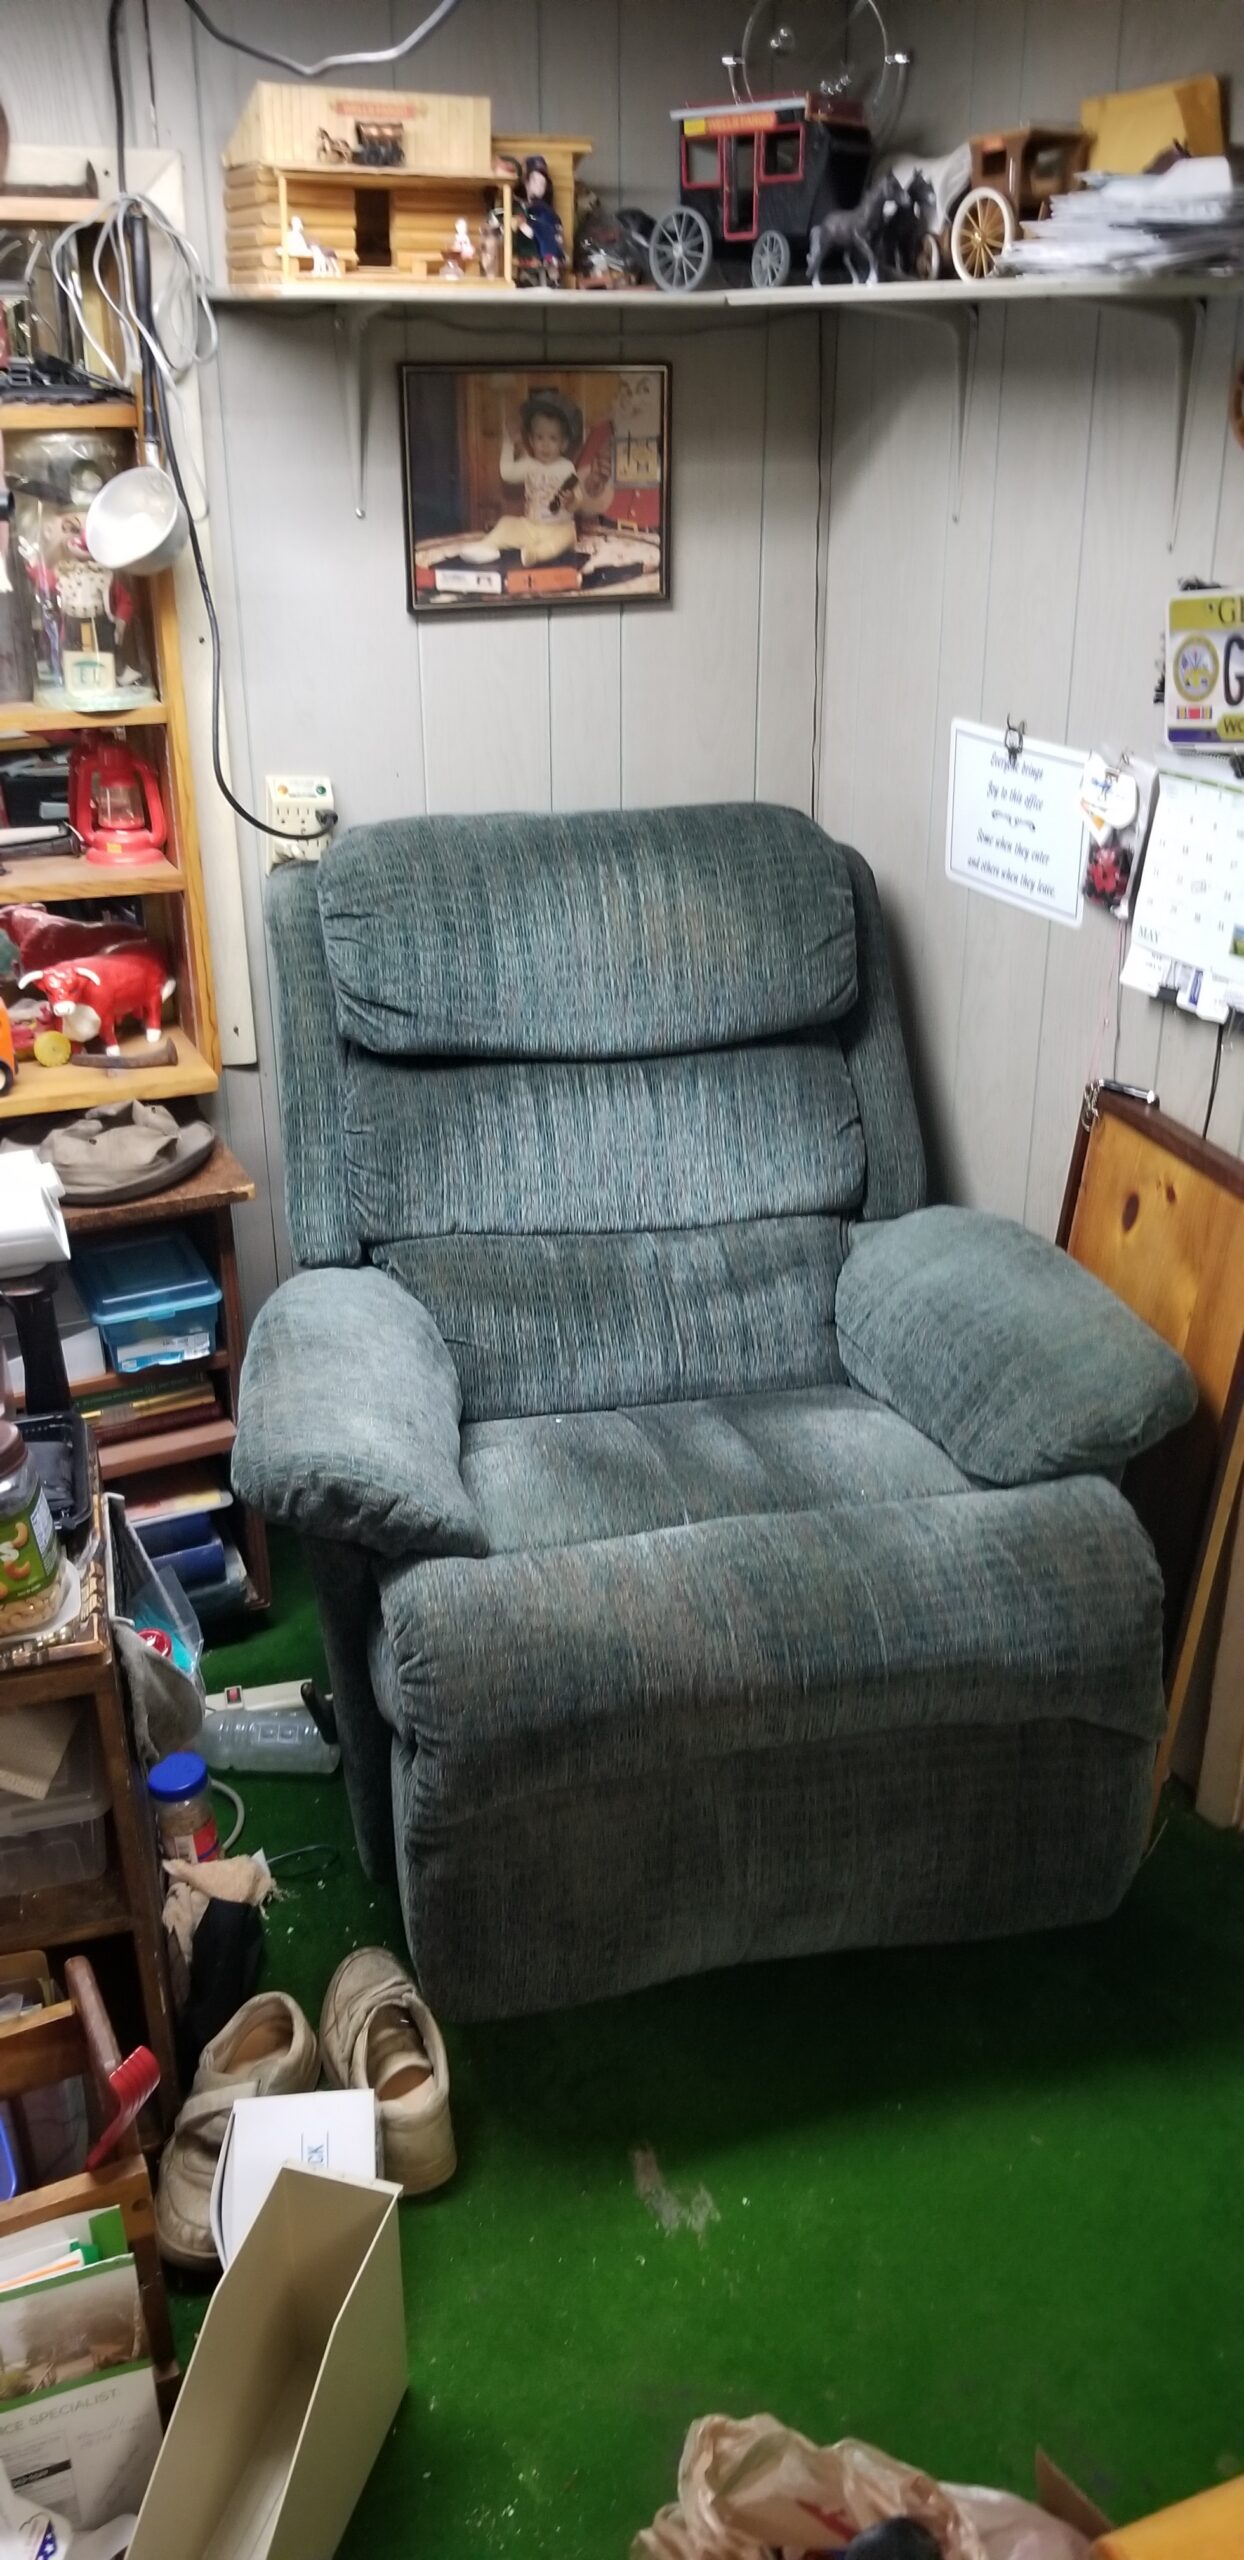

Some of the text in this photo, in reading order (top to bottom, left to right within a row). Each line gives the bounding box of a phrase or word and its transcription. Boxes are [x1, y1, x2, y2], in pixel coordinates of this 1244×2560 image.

[1021, 760, 1043, 782] brings
[1001, 786, 1008, 801] to
[1009, 788, 1022, 805] this
[1024, 793, 1043, 811] office
[977, 827, 1050, 866] Some when they enter
[968, 856, 980, 868] and
[980, 860, 999, 878] others
[1001, 867, 1018, 884] when
[1020, 873, 1035, 895] they
[1138, 924, 1160, 944] MAY
[29, 2388, 118, 2427] SPECIALIST
